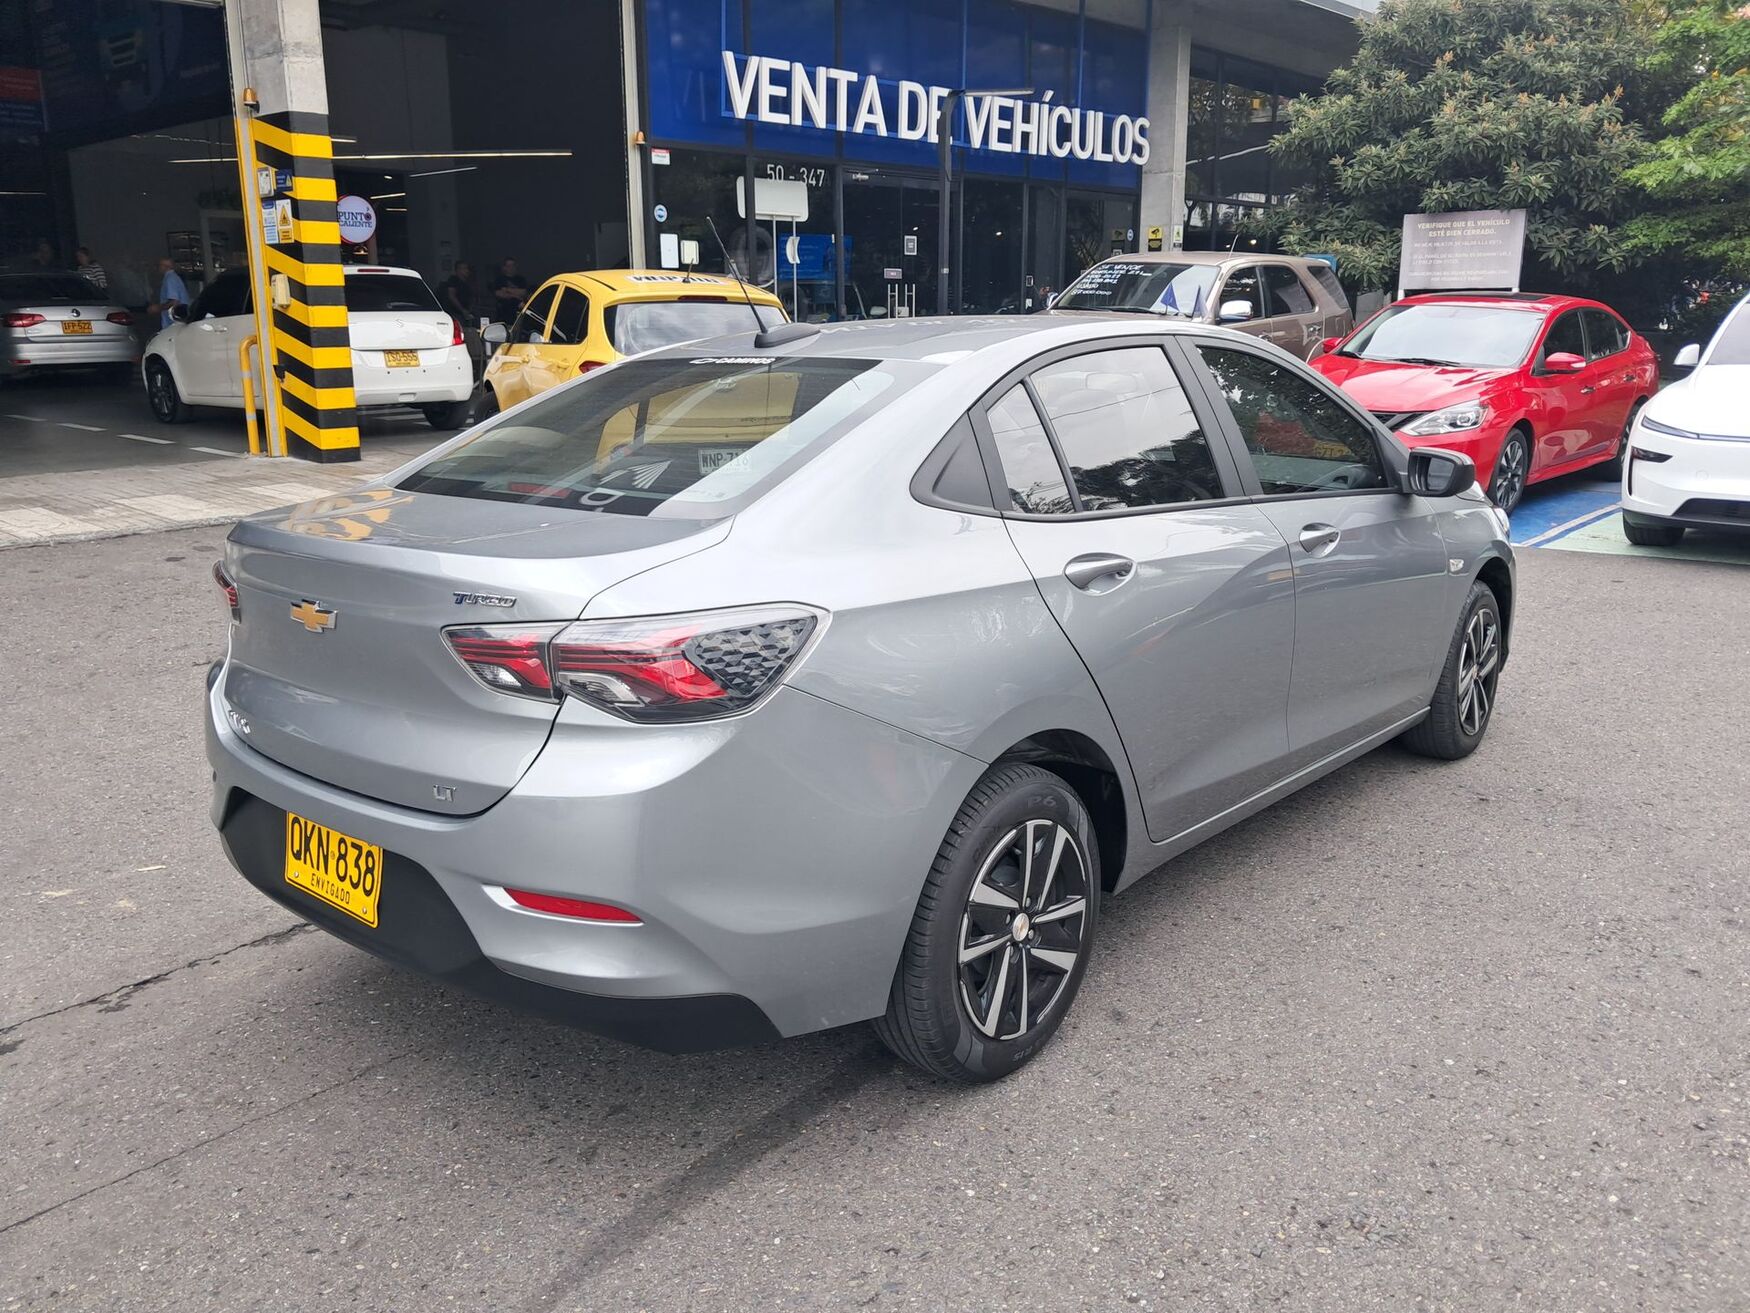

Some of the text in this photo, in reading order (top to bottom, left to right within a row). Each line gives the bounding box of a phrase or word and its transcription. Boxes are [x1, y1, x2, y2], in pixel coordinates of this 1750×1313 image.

[722, 50, 1151, 166] VENTA DE VEHÍCULOS
[767, 164, 784, 181] 50
[800, 168, 825, 187] 347
[1418, 221, 1452, 229] VERIFIQUE
[453, 591, 517, 608] TURBO
[433, 784, 456, 802] LT
[311, 873, 351, 905] ENVIGADO
